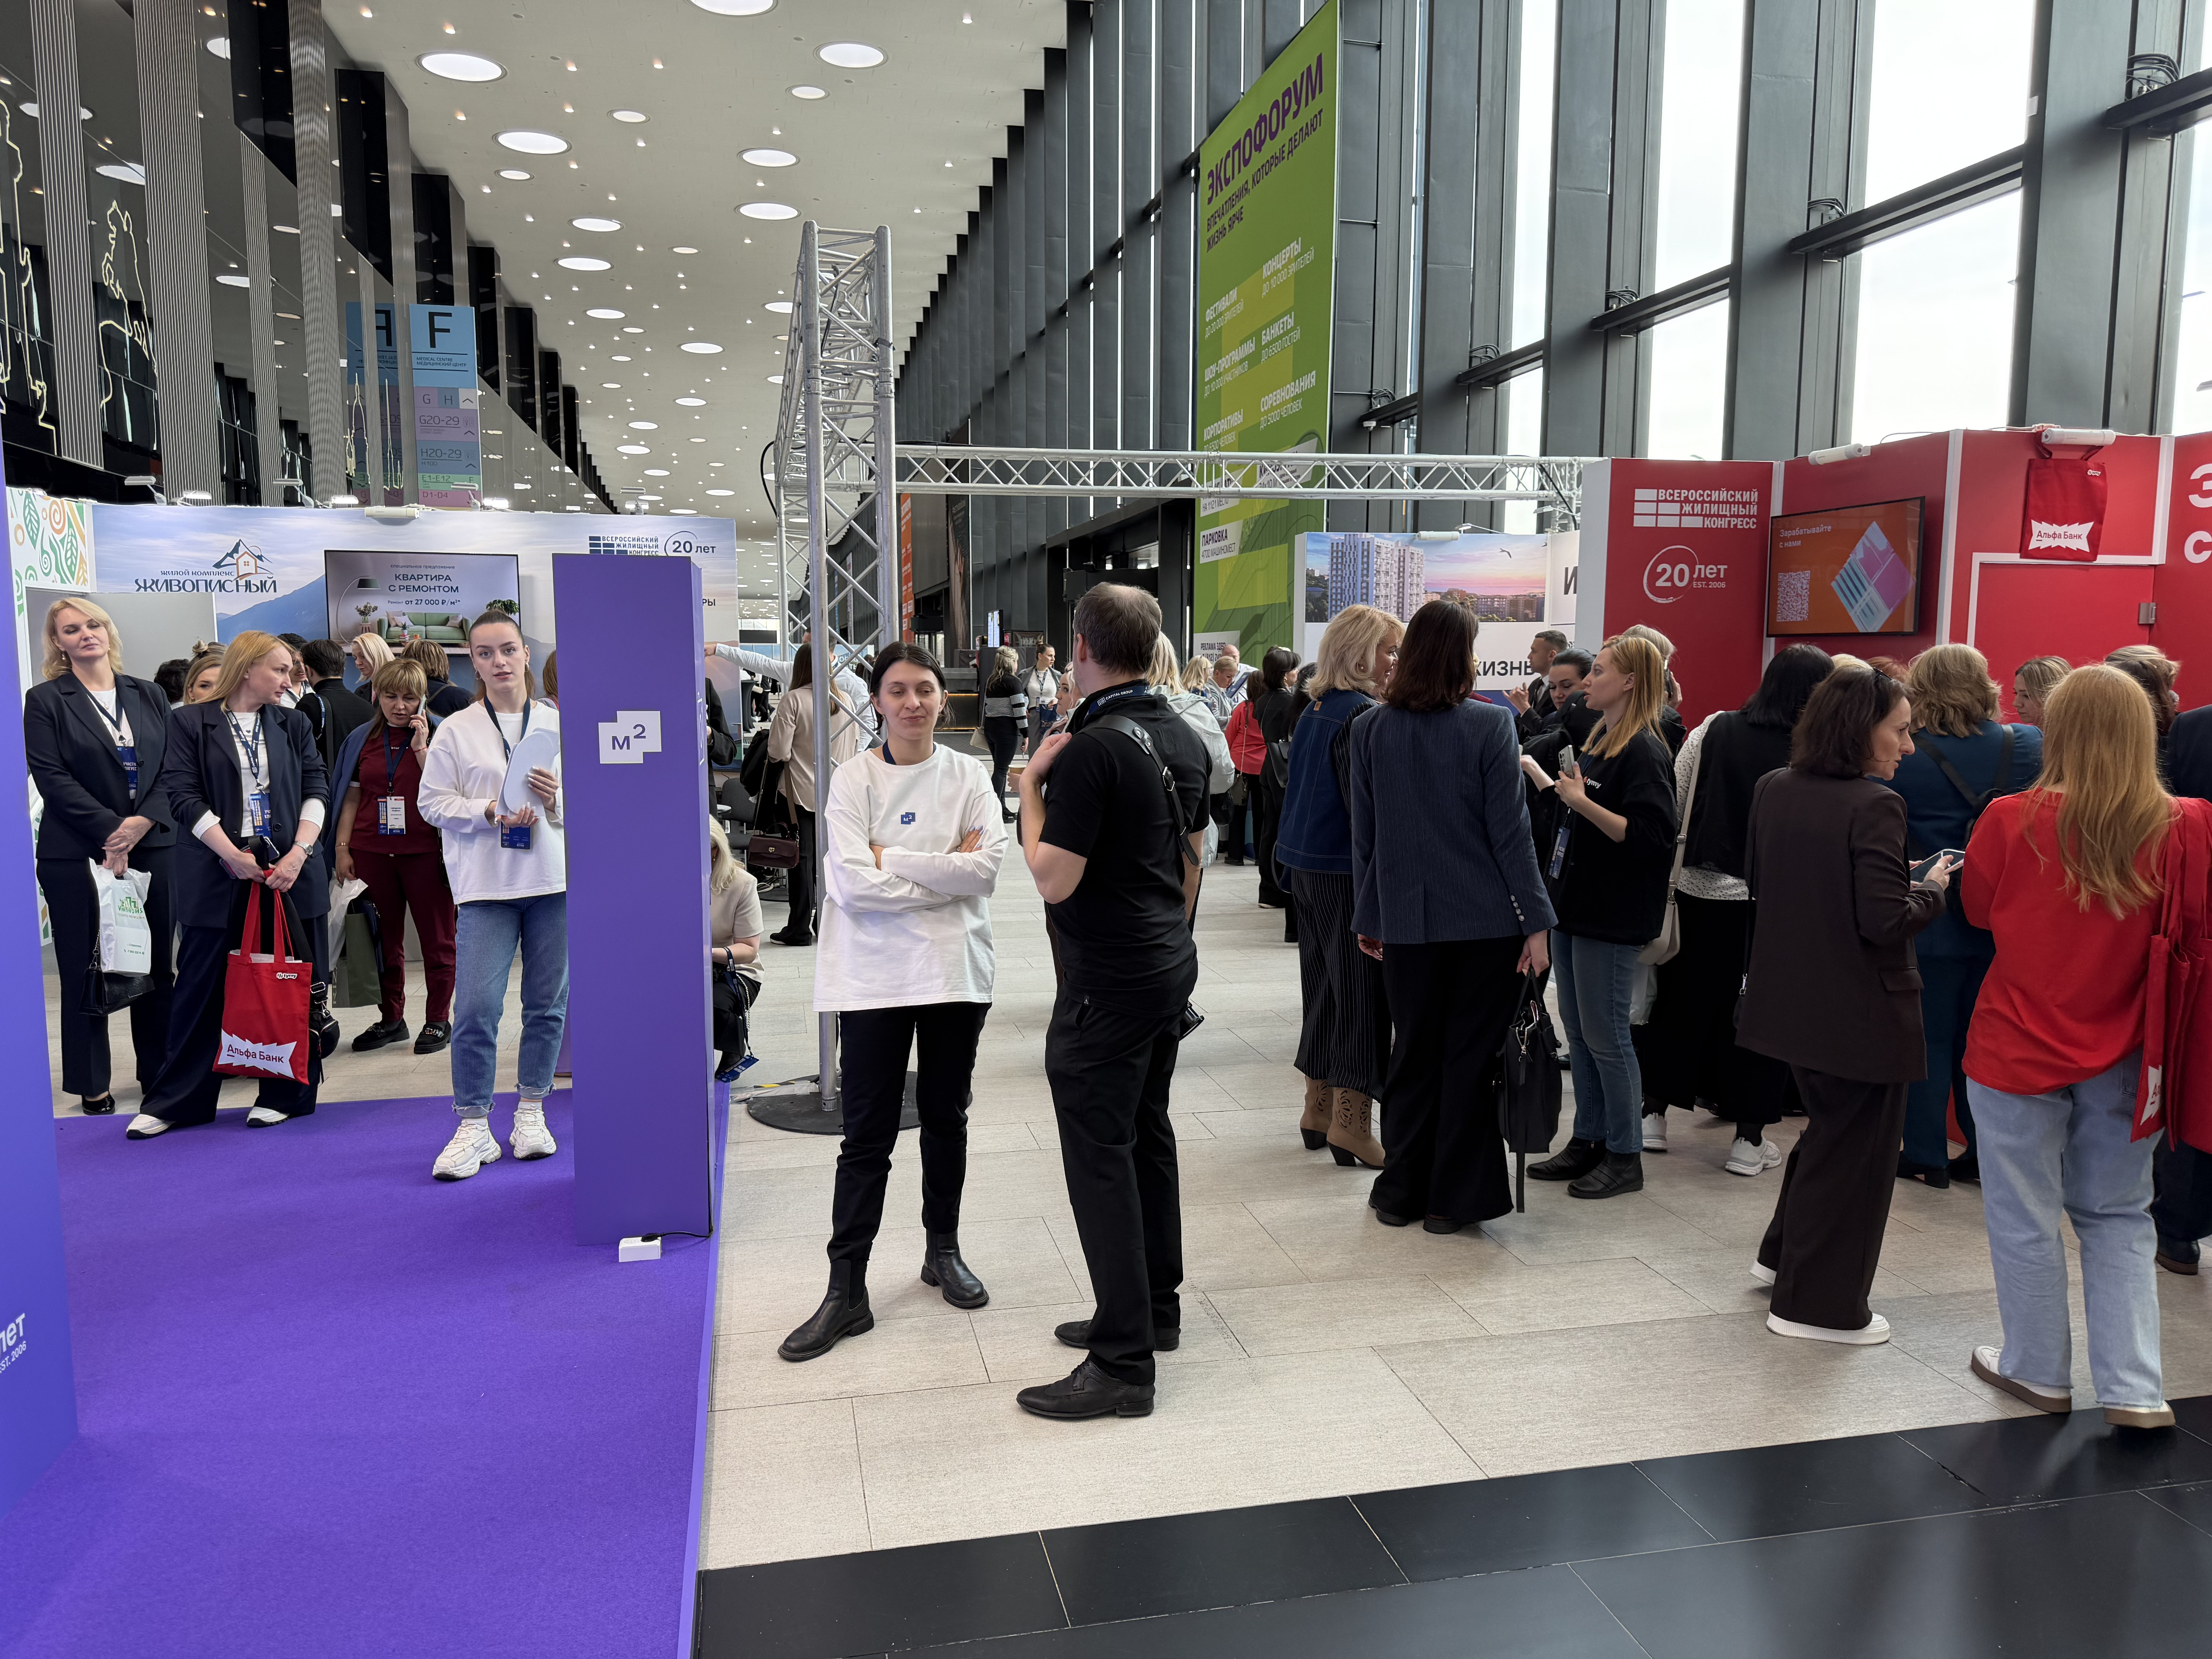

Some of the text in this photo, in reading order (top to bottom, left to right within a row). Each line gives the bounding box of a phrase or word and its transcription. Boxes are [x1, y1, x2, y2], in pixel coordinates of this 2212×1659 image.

[1207, 52, 1323, 206] ЭКСПОФОРУМ
[1207, 108, 1323, 233] ВПЕЧАТЛЕНИЯ, КОТОРЫЕ ДЕЛАЮТ
[1207, 205, 1244, 253] ЖИЗНЬ ЯРЧЕ
[1263, 237, 1301, 279] КОНЦЕРТЫ
[1206, 287, 1237, 322] ФЕСТИВАЛИ
[428, 311, 452, 349] F
[1262, 311, 1294, 345] БАНКЕТЫ
[1205, 337, 1255, 382] ШОУ-ПРОГРАММЫ
[423, 394, 431, 404] G
[445, 395, 452, 405] H
[1261, 370, 1316, 412] СОРЕВНОВАНИЯ
[419, 415, 460, 425] G20-29
[1204, 409, 1243, 441] КОРПОРАТИВЫ
[421, 448, 462, 459] H20-29
[1658, 488, 1758, 502] ВСЕРОССИЙСКИЙ
[1681, 502, 1757, 516] ЖИЛИЩНЫЙ
[1704, 517, 1757, 529] КОНГРЕСС
[1779, 524, 1832, 538] Зарабатывайте
[1202, 529, 1228, 547] ПАРКОВКА
[2036, 530, 2083, 541] Альфа Банк
[672, 540, 716, 553] 20 лет
[135, 576, 277, 592] ЖИВОПИСНЫЙ
[1655, 563, 1728, 587] 20 лет
[227, 1044, 285, 1063] Альфа Банк
[11, 1341, 27, 1362] 2006
